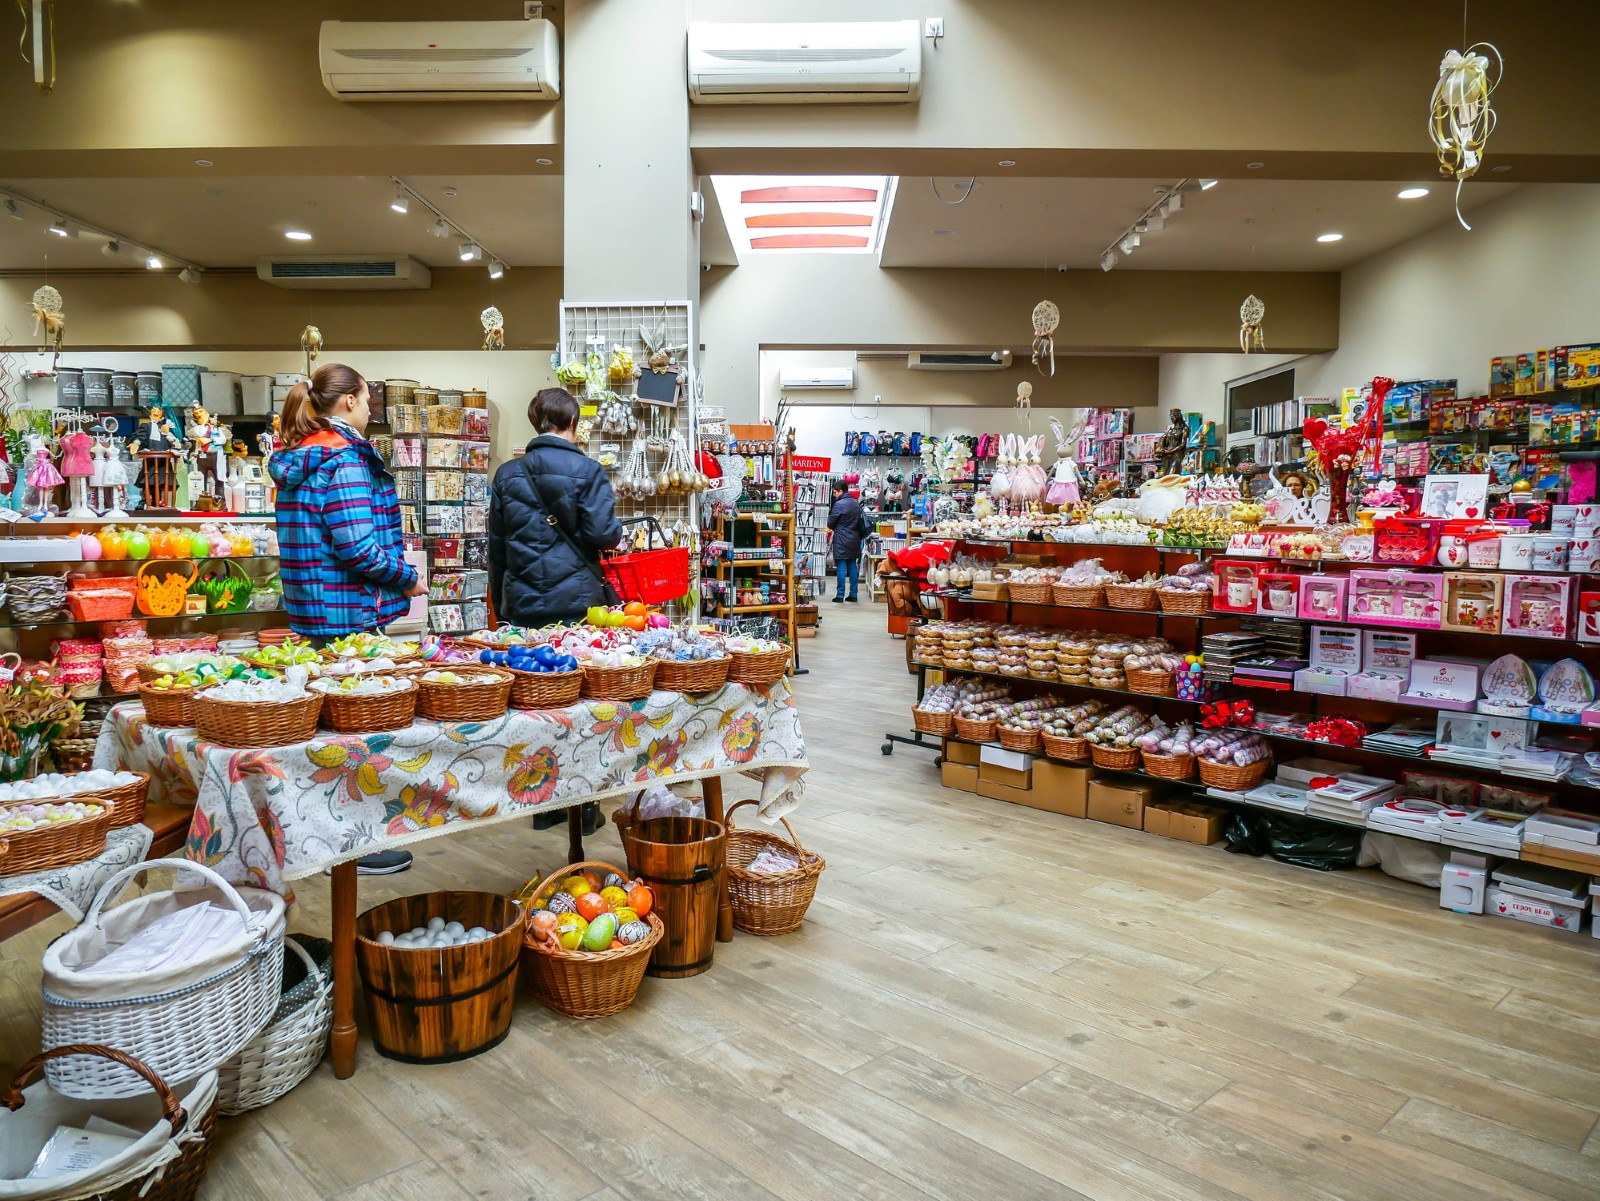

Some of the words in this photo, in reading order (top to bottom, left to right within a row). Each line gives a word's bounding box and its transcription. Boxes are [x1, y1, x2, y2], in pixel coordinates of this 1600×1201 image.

[791, 459, 824, 468] MARILYN
[1512, 903, 1532, 913] TEDDY
[1534, 907, 1551, 916] BEAR
